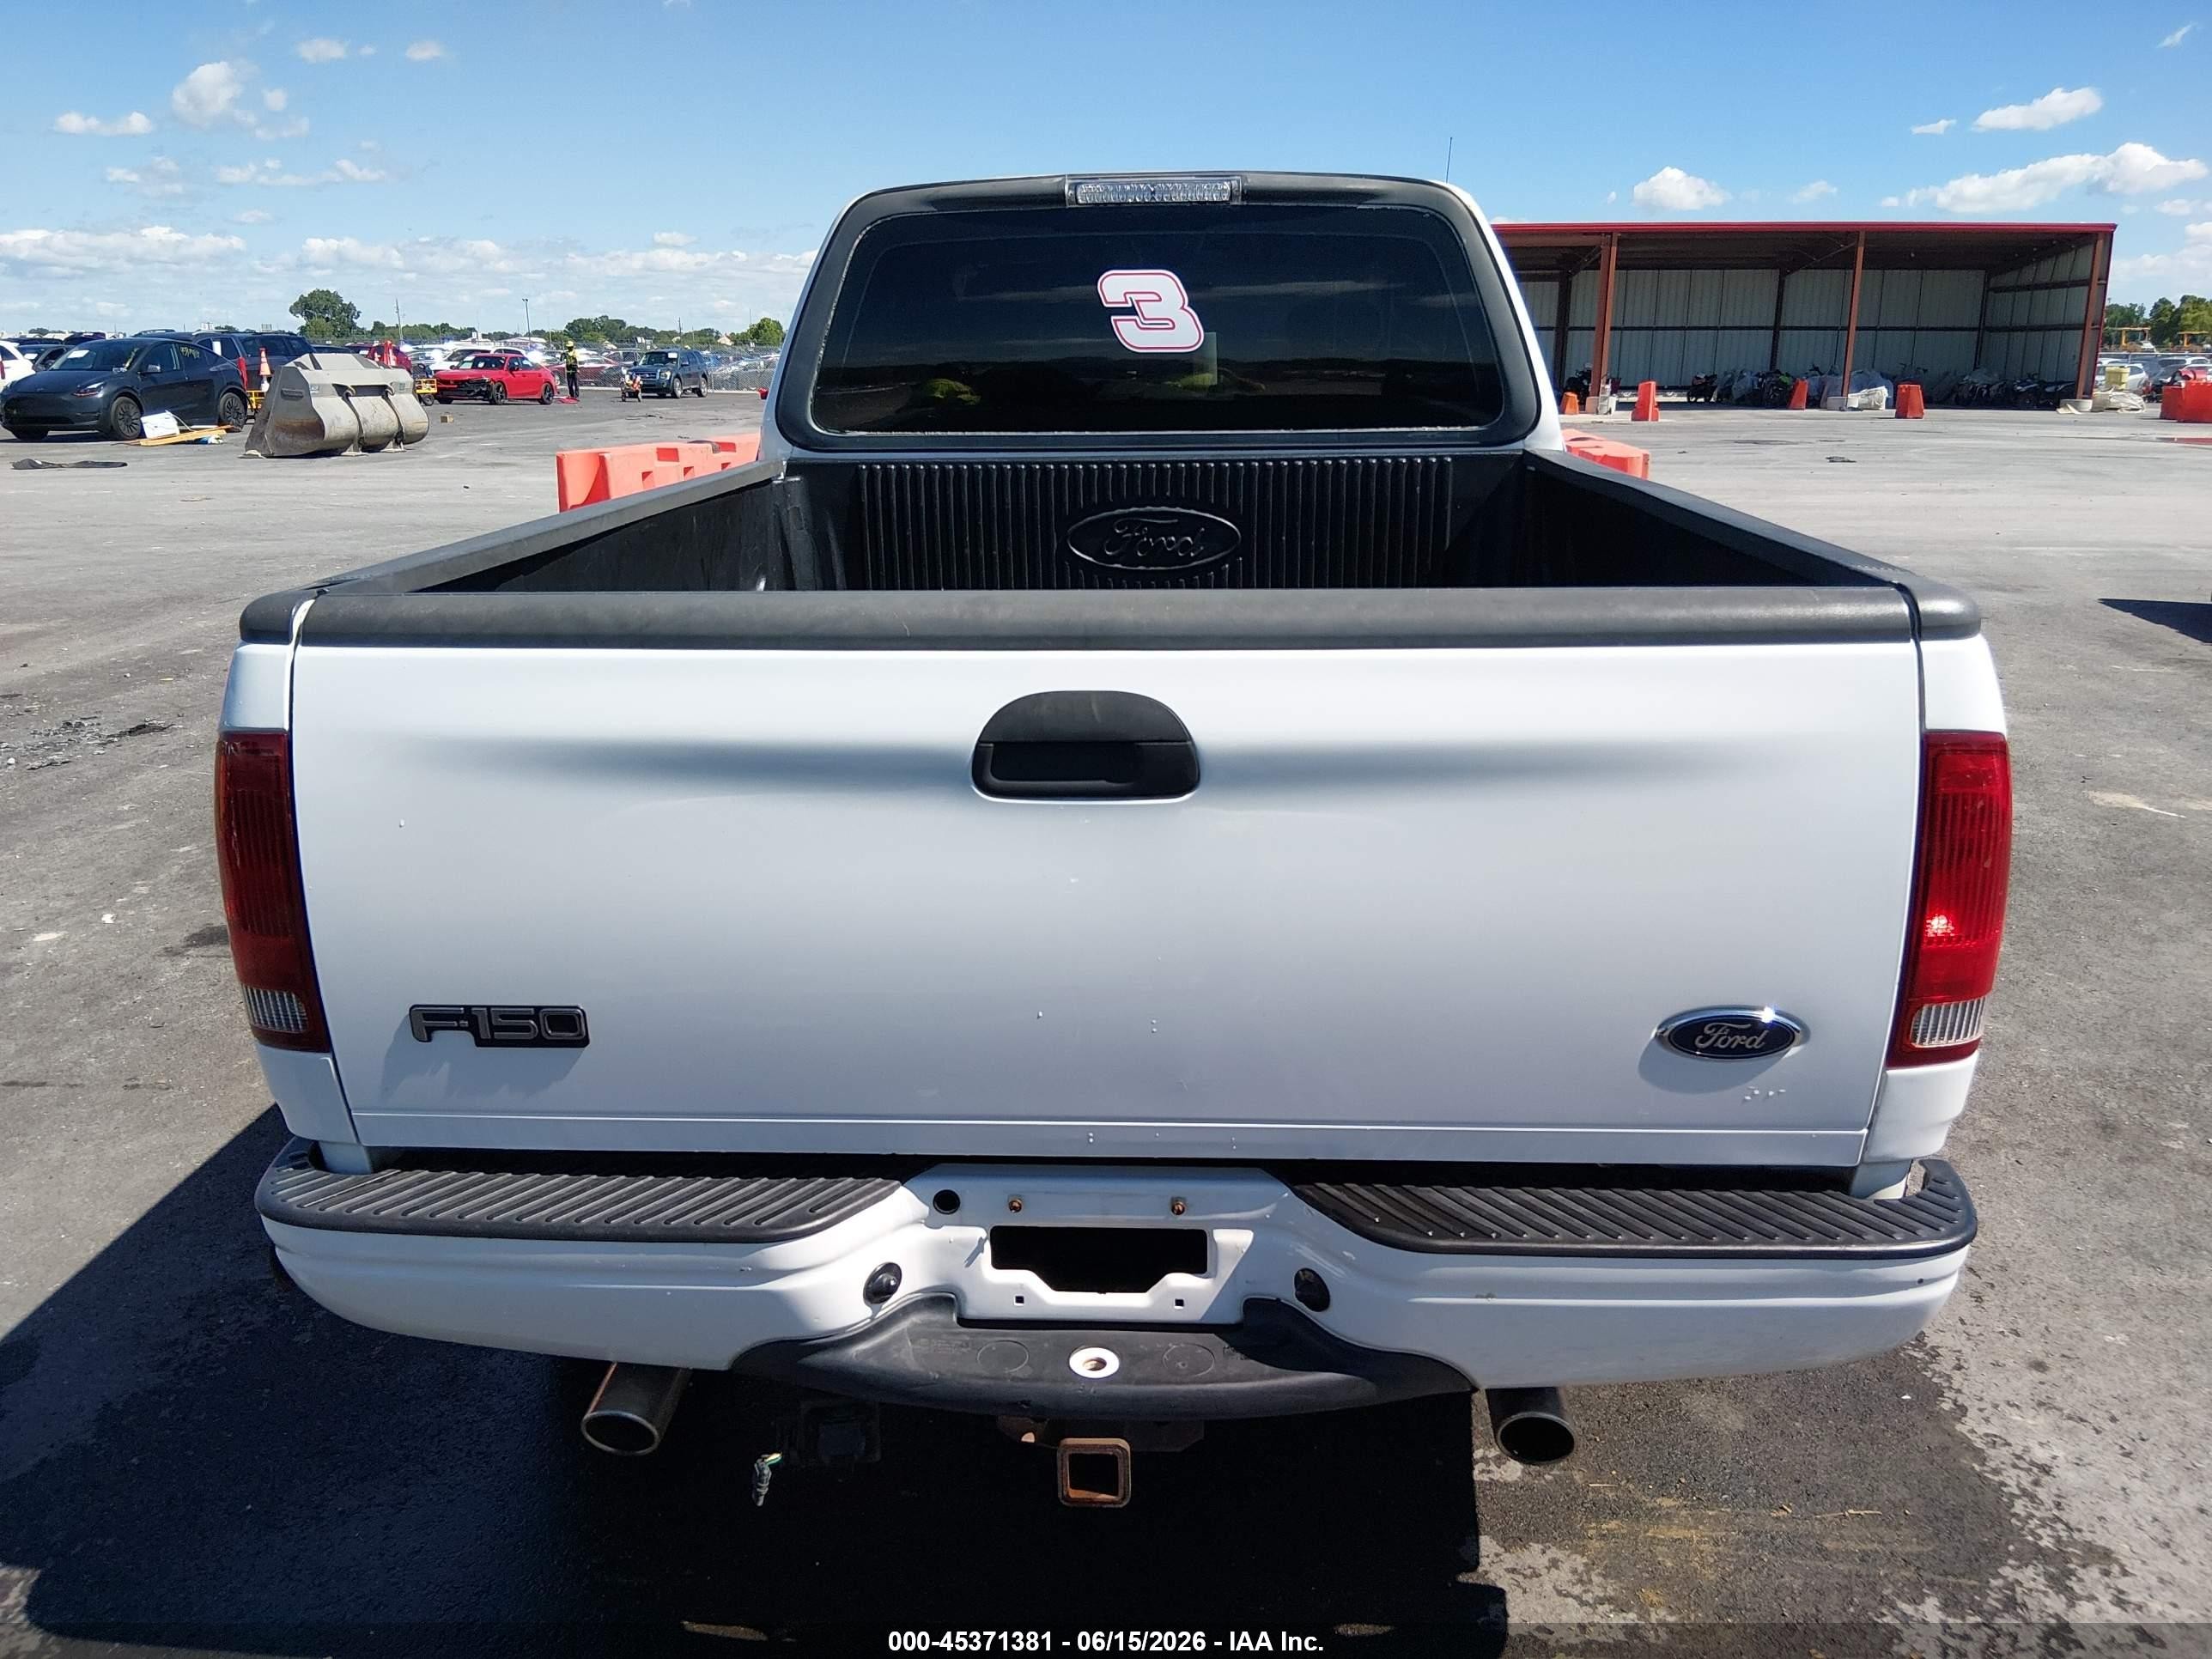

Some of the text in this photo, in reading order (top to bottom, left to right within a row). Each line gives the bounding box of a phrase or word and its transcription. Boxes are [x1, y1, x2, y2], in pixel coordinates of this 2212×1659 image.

[1097, 269, 1204, 353] 3
[1104, 518, 1206, 557] Ford
[410, 1006, 588, 1044] F-150
[1694, 1022, 1768, 1049] Ford
